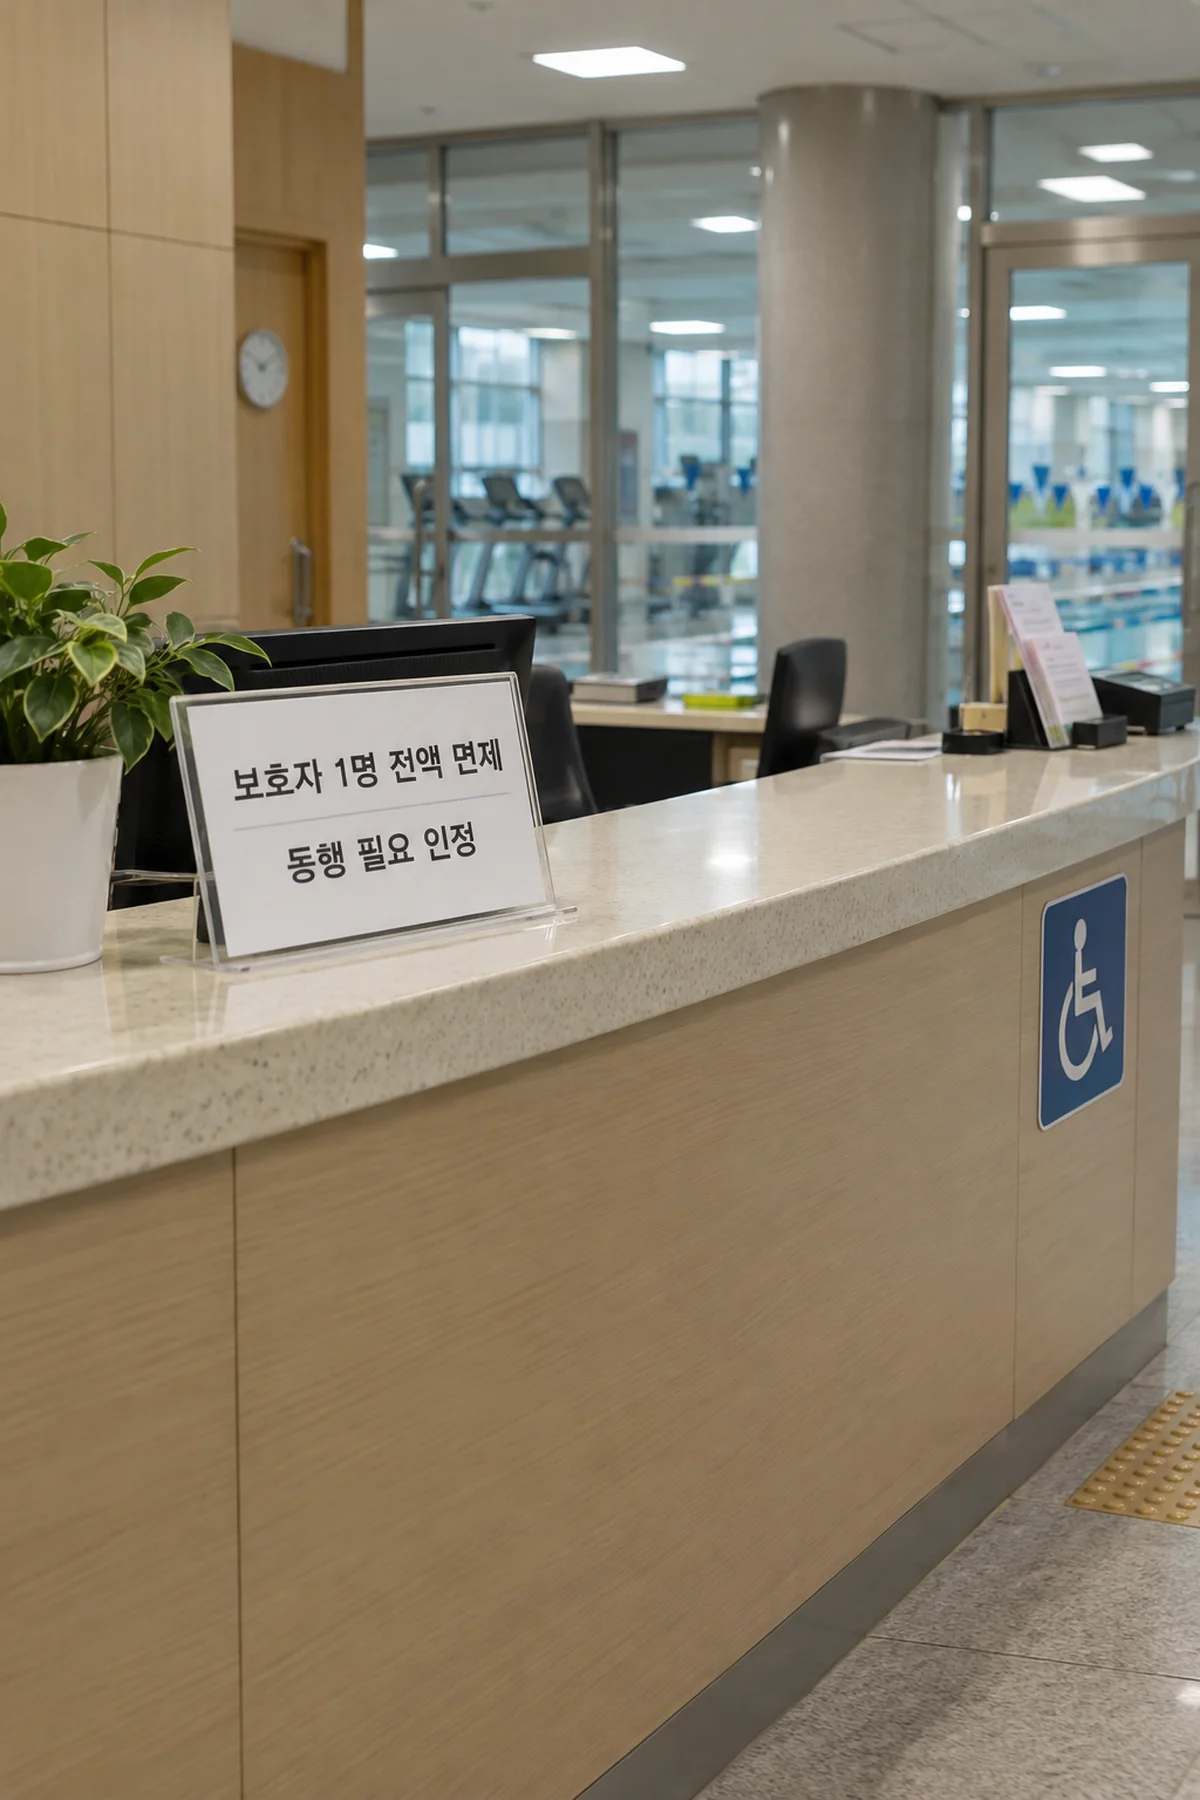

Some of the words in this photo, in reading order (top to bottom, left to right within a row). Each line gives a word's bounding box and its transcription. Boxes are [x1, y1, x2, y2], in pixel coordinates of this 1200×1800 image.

[234, 759, 322, 801] 보호자
[335, 752, 378, 788] 1명
[389, 745, 443, 783] 전액
[452, 738, 503, 775] 면제
[288, 841, 346, 883] 동행
[357, 833, 414, 872] 필요
[424, 822, 476, 861] 인정
